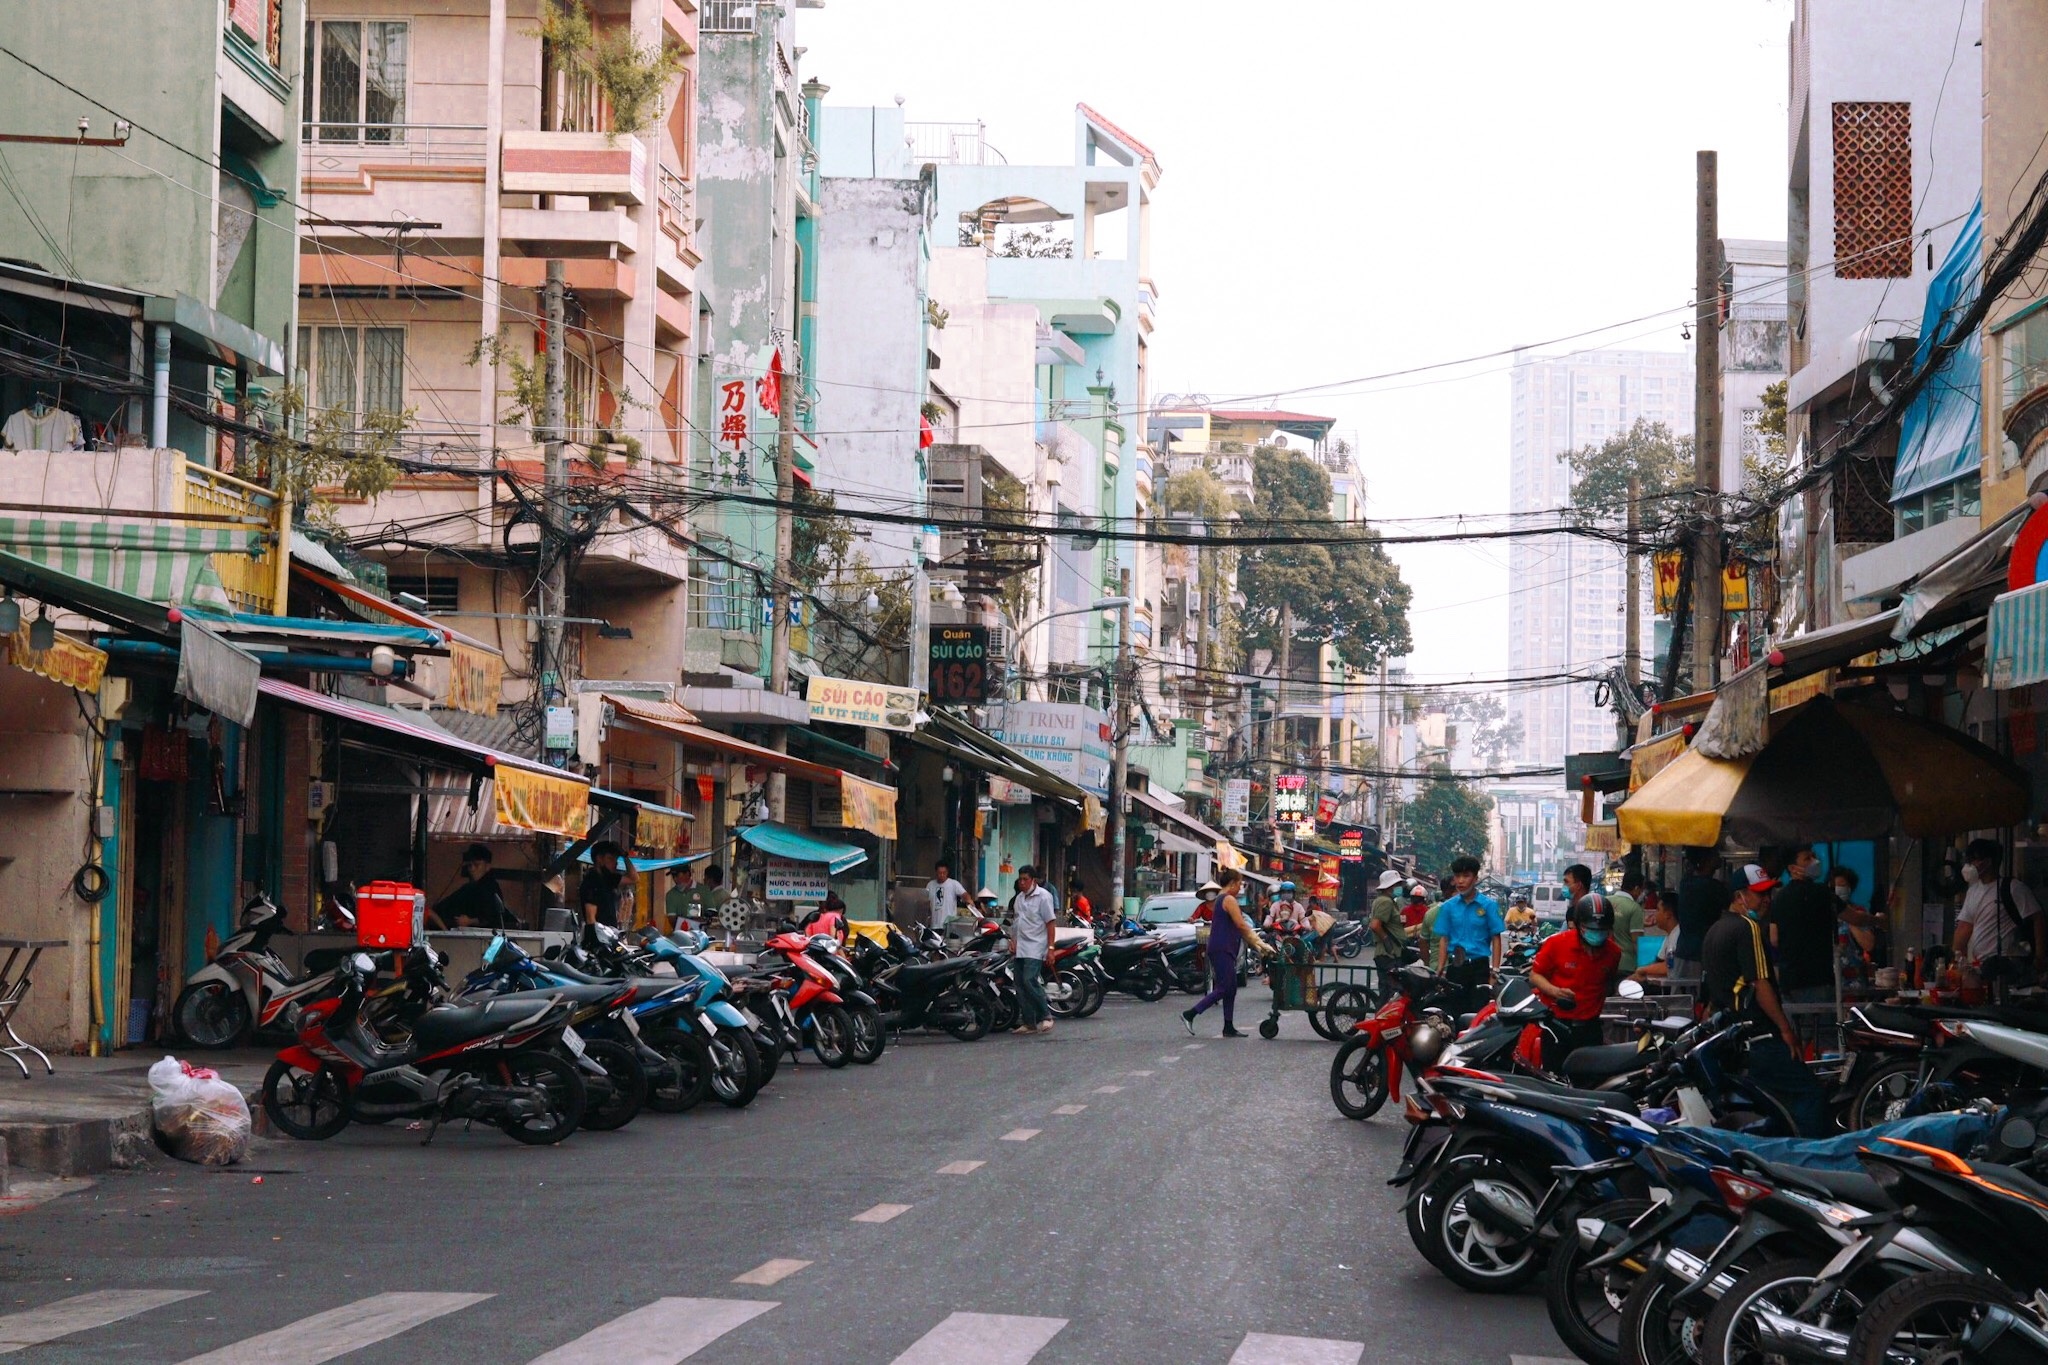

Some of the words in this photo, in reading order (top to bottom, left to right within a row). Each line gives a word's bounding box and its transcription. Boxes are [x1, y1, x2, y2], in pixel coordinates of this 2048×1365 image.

[721, 381, 747, 450] 乃輝
[943, 629, 971, 639] Quán
[931, 641, 953, 658] SỦI
[956, 641, 983, 658] CẢO
[933, 663, 982, 698] 162
[821, 684, 848, 704] SỦI
[853, 686, 884, 706] CẢO
[1050, 736, 1066, 746] BAY
[1047, 750, 1073, 762] KHÔNG
[1278, 778, 1305, 789] 157
[371, 1069, 400, 1082] YAMAHA
